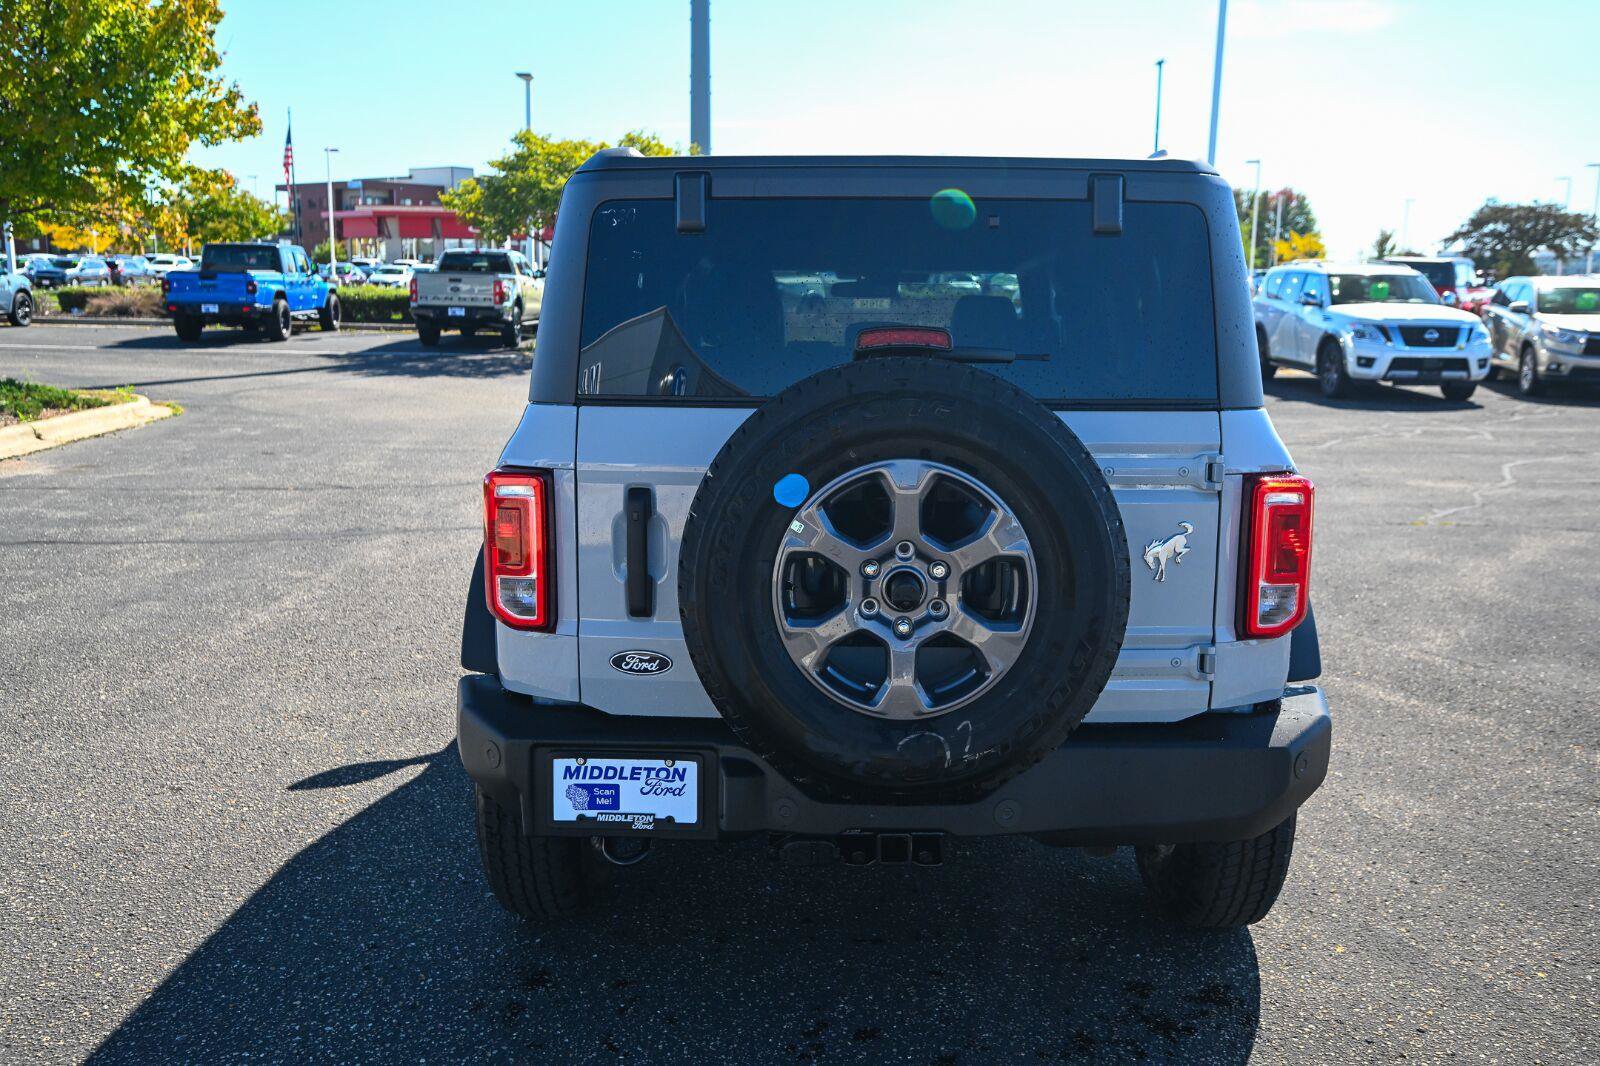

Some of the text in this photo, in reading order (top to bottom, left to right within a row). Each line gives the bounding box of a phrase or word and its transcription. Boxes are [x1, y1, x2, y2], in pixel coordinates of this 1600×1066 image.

[621, 654, 660, 671] Ford
[562, 765, 687, 781] MIDDLETON
[639, 777, 687, 797] Ford
[593, 788, 615, 796] Scan
[596, 797, 612, 805] Me!
[597, 814, 654, 823] MIDDLETON
[632, 821, 655, 830] Ford
